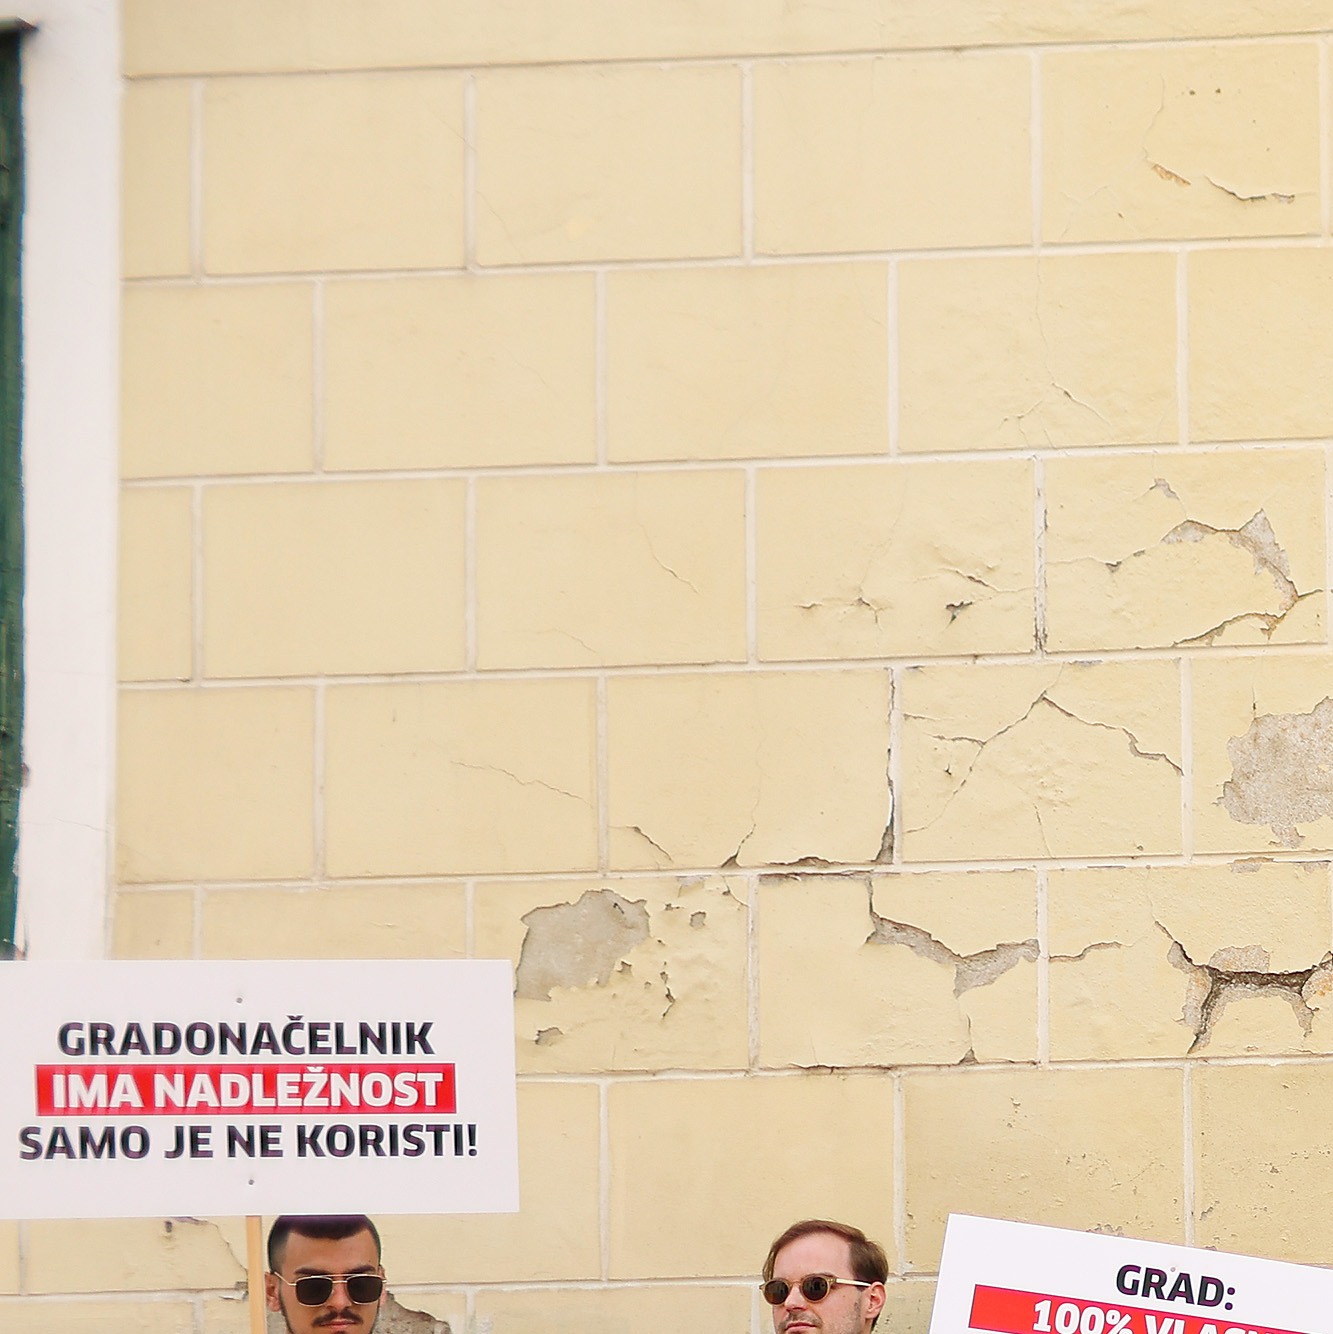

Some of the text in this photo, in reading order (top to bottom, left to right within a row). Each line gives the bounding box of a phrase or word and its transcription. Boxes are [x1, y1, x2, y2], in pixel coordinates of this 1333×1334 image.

[57, 1015, 435, 1056] GRADONAČELNIK
[52, 1066, 444, 1109] IMA NADLEŽNOST
[18, 1123, 478, 1160] SAMO JE NE KORISTI!
[1116, 1263, 1236, 1310] GRAD:
